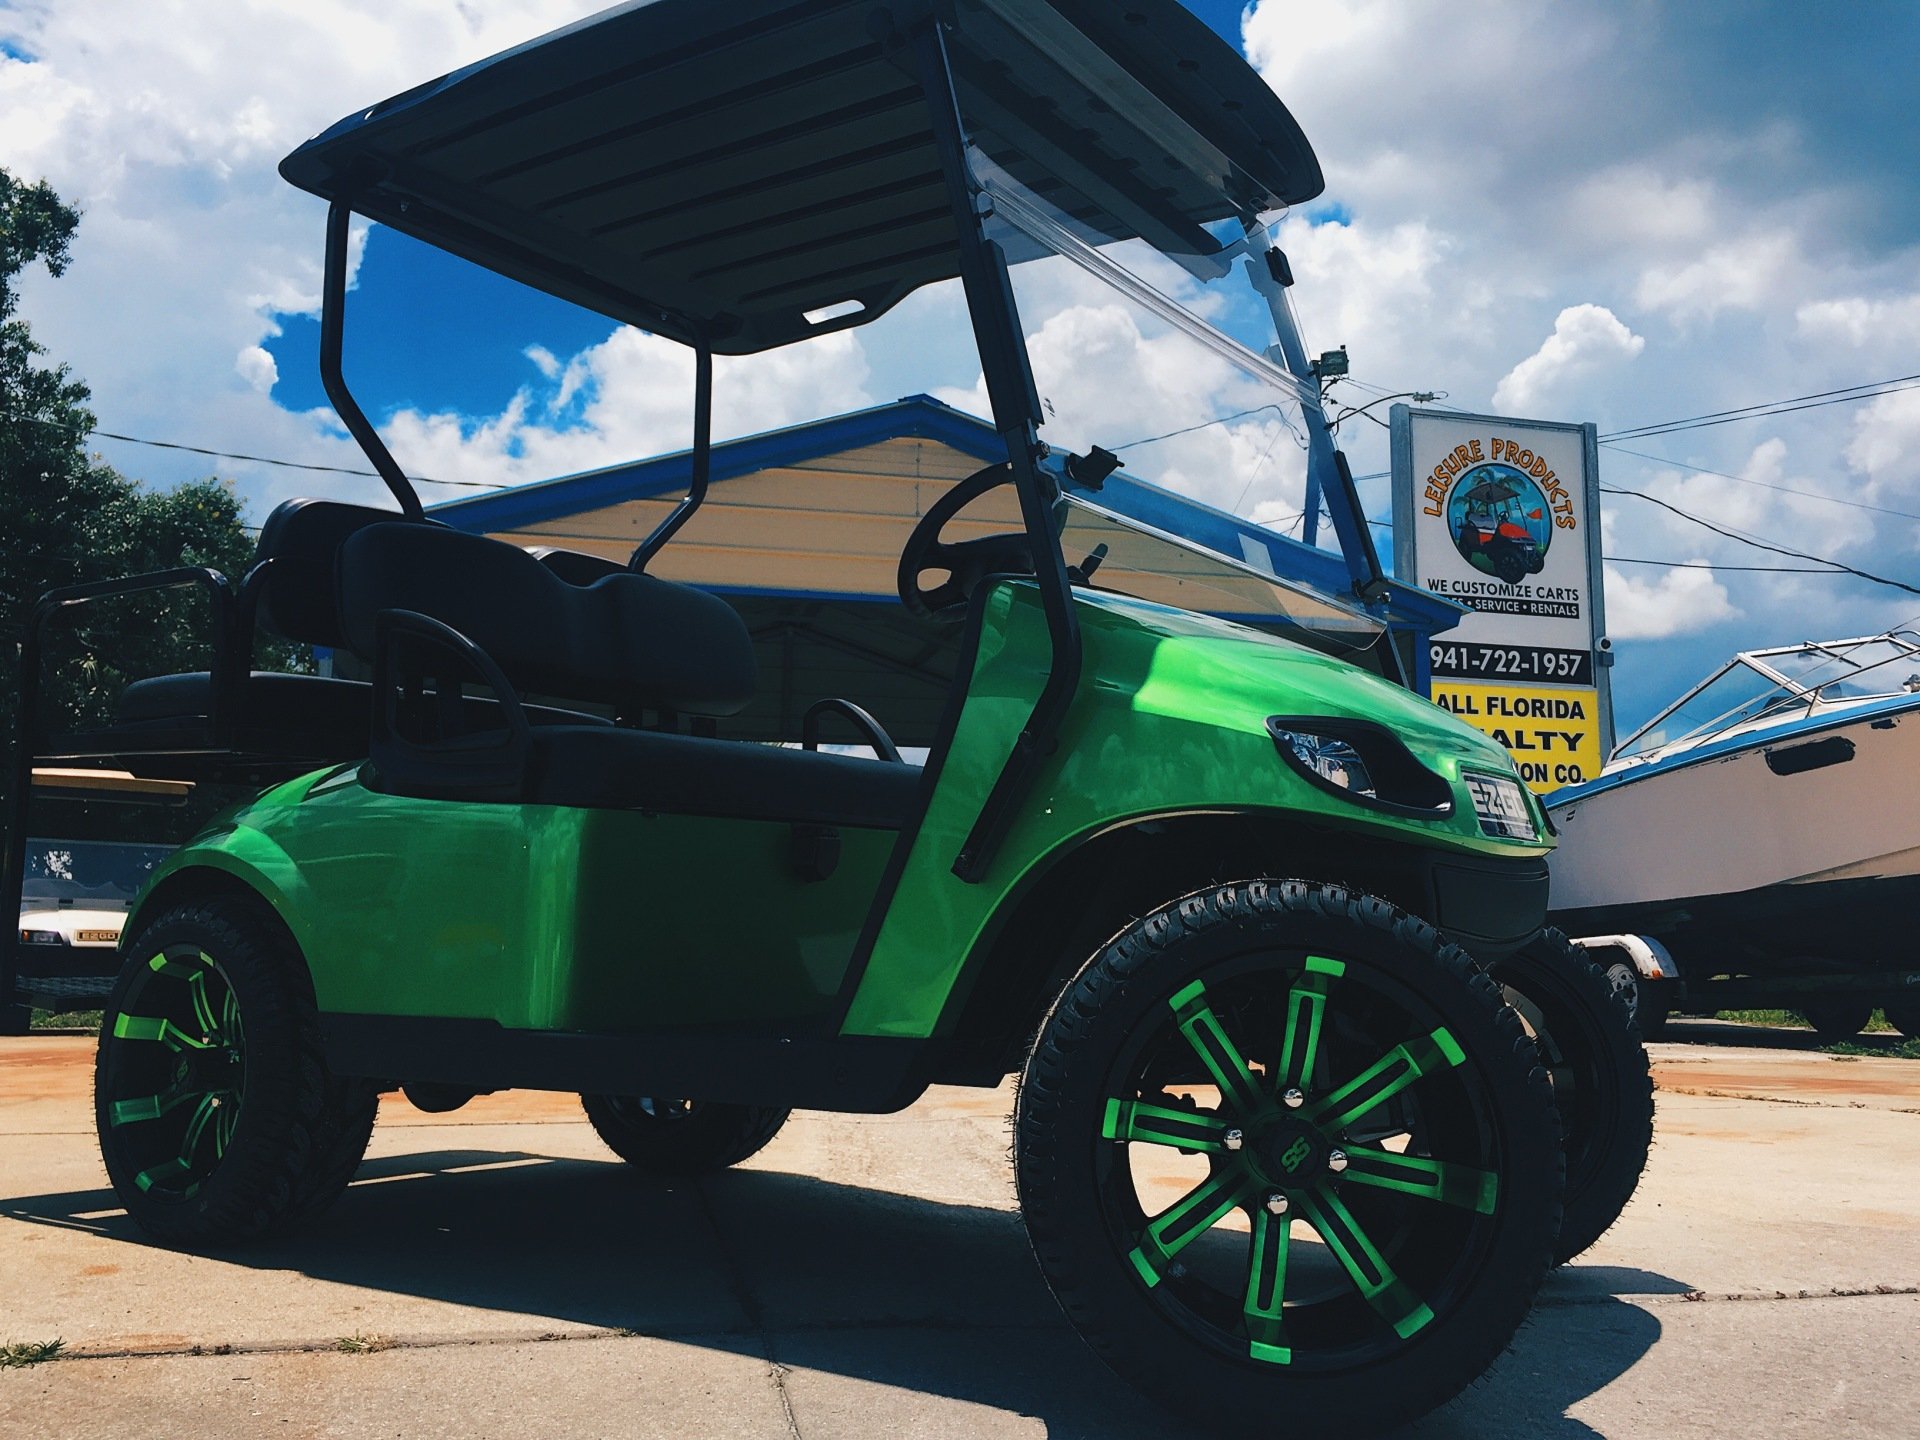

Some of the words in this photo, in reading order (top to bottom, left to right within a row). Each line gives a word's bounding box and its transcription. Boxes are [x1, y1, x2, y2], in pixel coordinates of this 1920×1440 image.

[1490, 437, 1577, 530] PRODUCTS
[1427, 578, 1448, 592] WE
[1452, 580, 1532, 598] CUSTOMIZE
[1536, 586, 1579, 601] CARTS
[1475, 599, 1520, 612] SERVICE
[1530, 603, 1577, 616] RENTALS
[1430, 645, 1582, 677] 941-722-1957
[1436, 693, 1479, 714] ALL
[1486, 696, 1586, 720] FLORIDA
[1554, 764, 1587, 783] CO.
